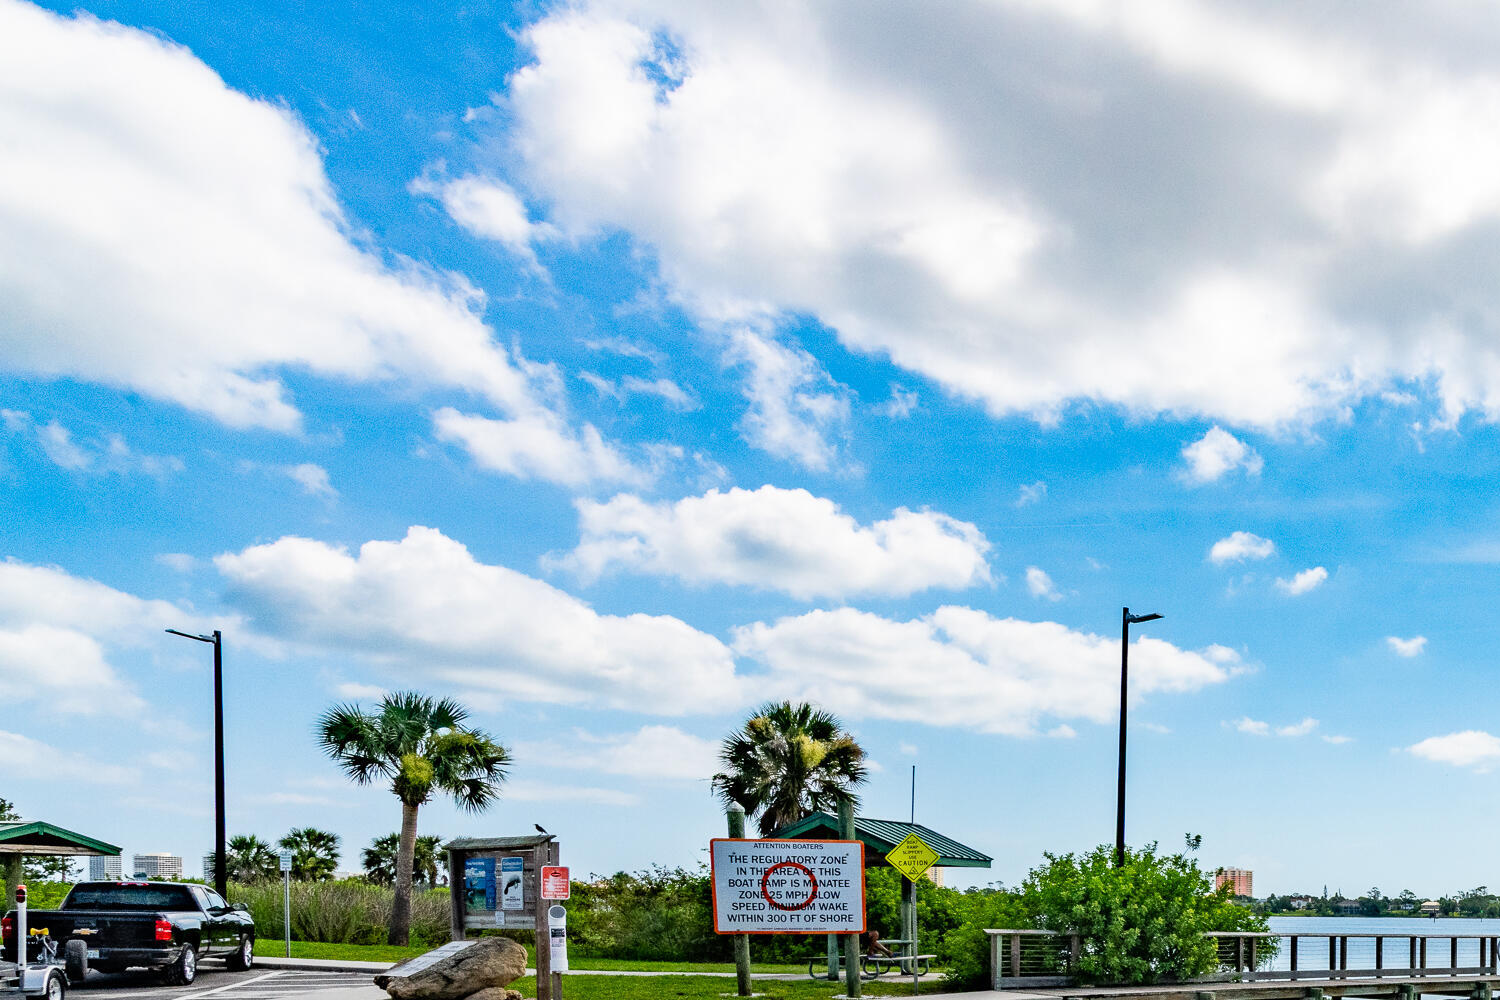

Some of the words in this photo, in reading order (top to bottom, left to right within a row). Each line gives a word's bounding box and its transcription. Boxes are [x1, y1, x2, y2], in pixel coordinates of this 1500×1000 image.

[728, 855, 748, 864] THE
[751, 855, 818, 864] REGULATORY
[820, 856, 848, 865] ZONE
[736, 867, 747, 876] IN
[749, 867, 769, 876] THE
[772, 867, 800, 876] AREA
[802, 867, 816, 876] OF
[819, 868, 841, 877] THIS
[728, 878, 754, 888] BOAT
[757, 878, 788, 888] RAMP
[790, 878, 801, 888] IS
[803, 878, 850, 888] MANATEE
[738, 890, 766, 900] ZONE
[768, 890, 783, 900] 25
[785, 890, 809, 900] MPH
[811, 890, 841, 900] SLOW
[731, 902, 766, 911] SPEED
[768, 902, 816, 911] MINIMUM
[818, 902, 849, 911] WAKE
[727, 914, 764, 923] WITHIN
[766, 914, 788, 923] 300
[789, 914, 801, 923] FT
[803, 914, 817, 923] OF
[819, 914, 854, 923] SHORE
